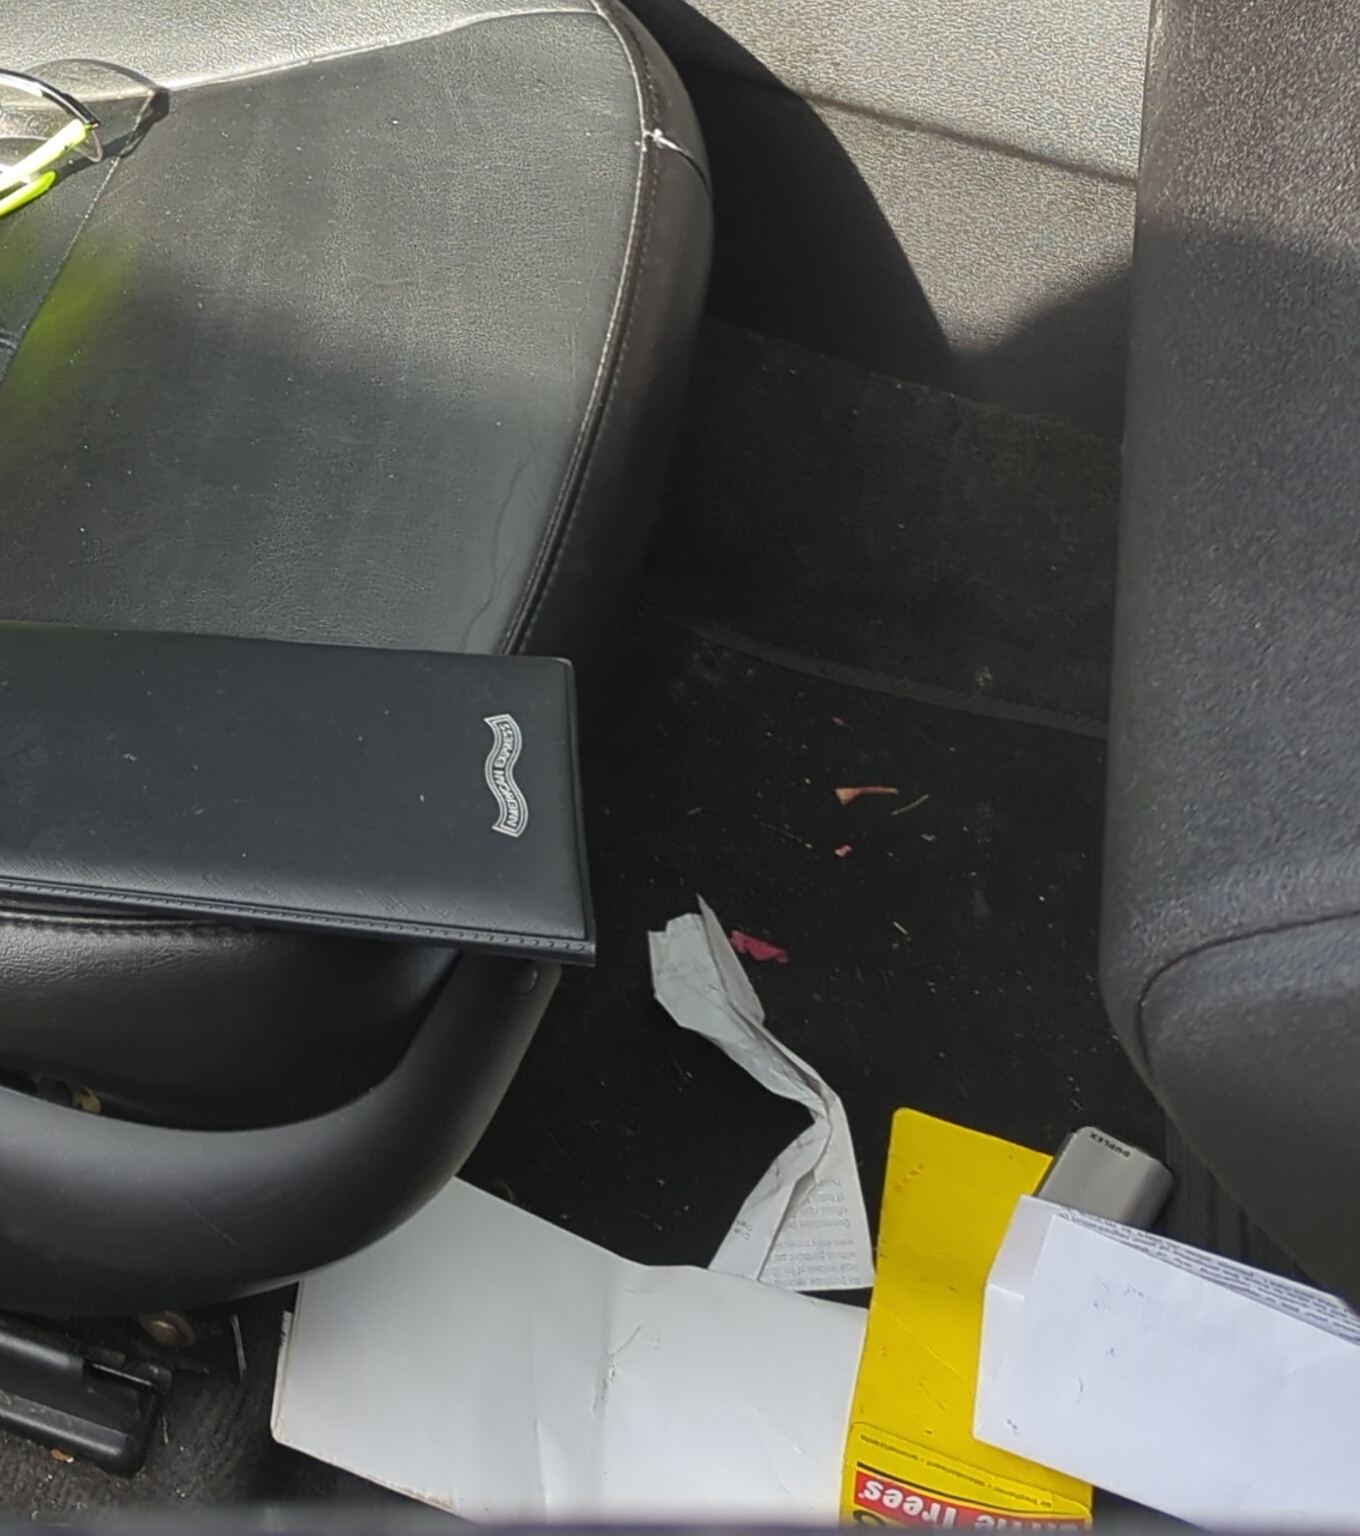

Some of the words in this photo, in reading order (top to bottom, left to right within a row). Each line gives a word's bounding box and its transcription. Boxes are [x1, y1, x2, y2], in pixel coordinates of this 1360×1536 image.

[493, 722, 514, 768] EXPRESS
[493, 768, 520, 827] AMERICAN
[1089, 1131, 1131, 1157] DUPLEX
[863, 1480, 957, 1529] Trees
